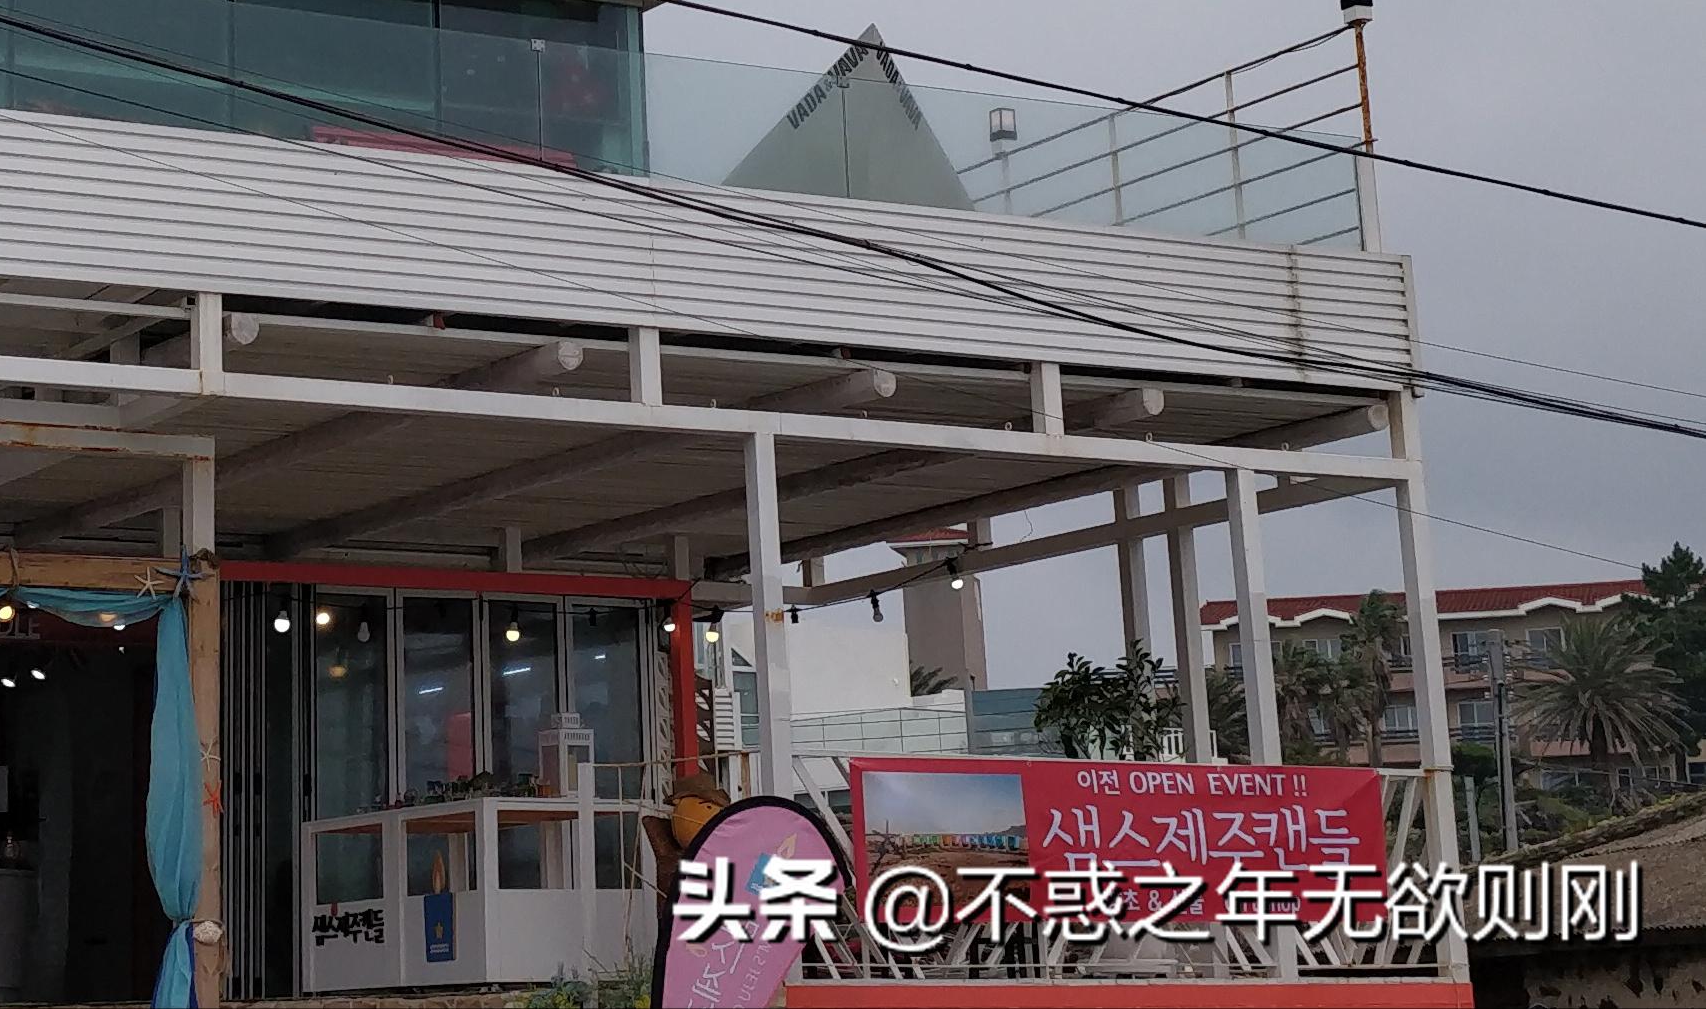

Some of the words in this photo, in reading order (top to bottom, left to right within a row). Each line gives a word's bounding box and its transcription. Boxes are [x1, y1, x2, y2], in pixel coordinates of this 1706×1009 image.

[787, 84, 827, 129] VADA
[1077, 769, 1121, 795] 이전
[1129, 771, 1194, 795] OPEN
[1207, 773, 1287, 797] EVENT
